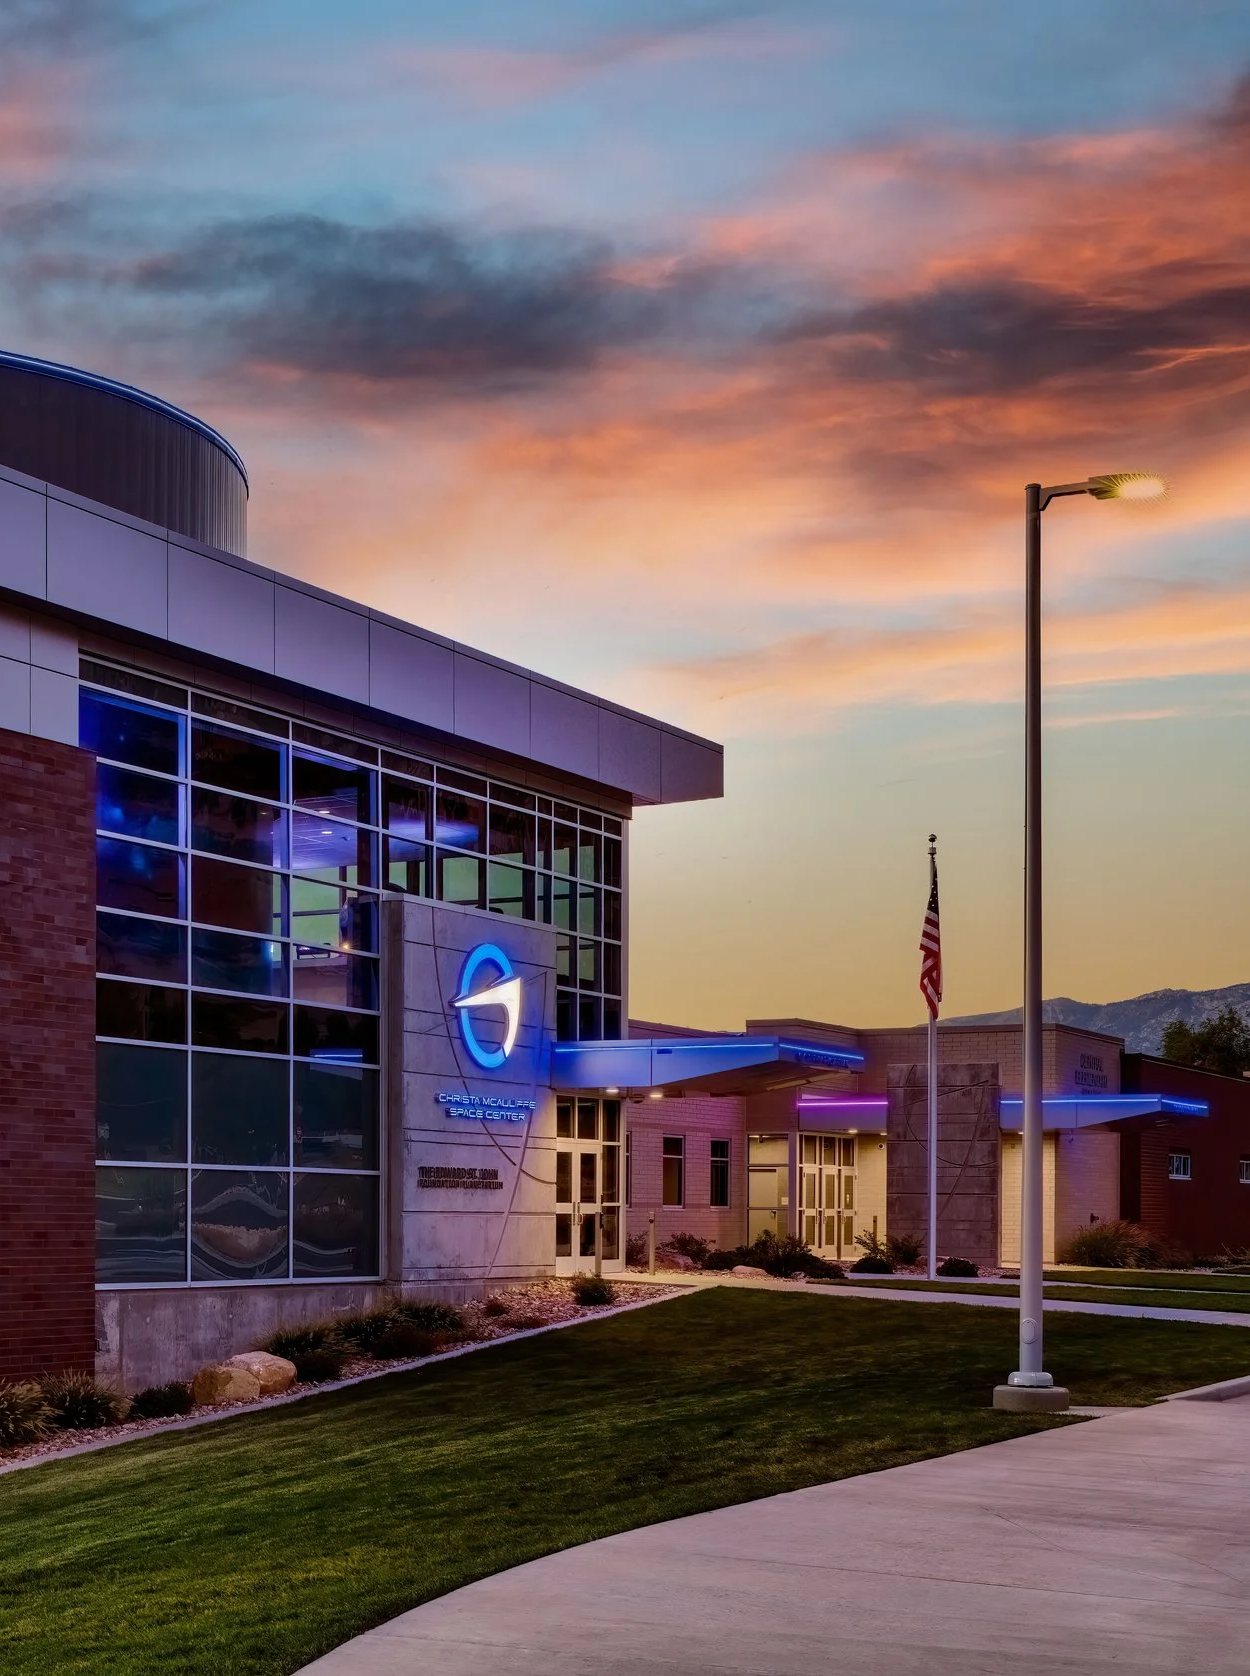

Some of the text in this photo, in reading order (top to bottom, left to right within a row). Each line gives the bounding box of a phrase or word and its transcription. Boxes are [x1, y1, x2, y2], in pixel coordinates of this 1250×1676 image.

[437, 1093, 536, 1109] CHRISTA MCAULIFFE
[448, 1107, 526, 1121] SPACE CENTER
